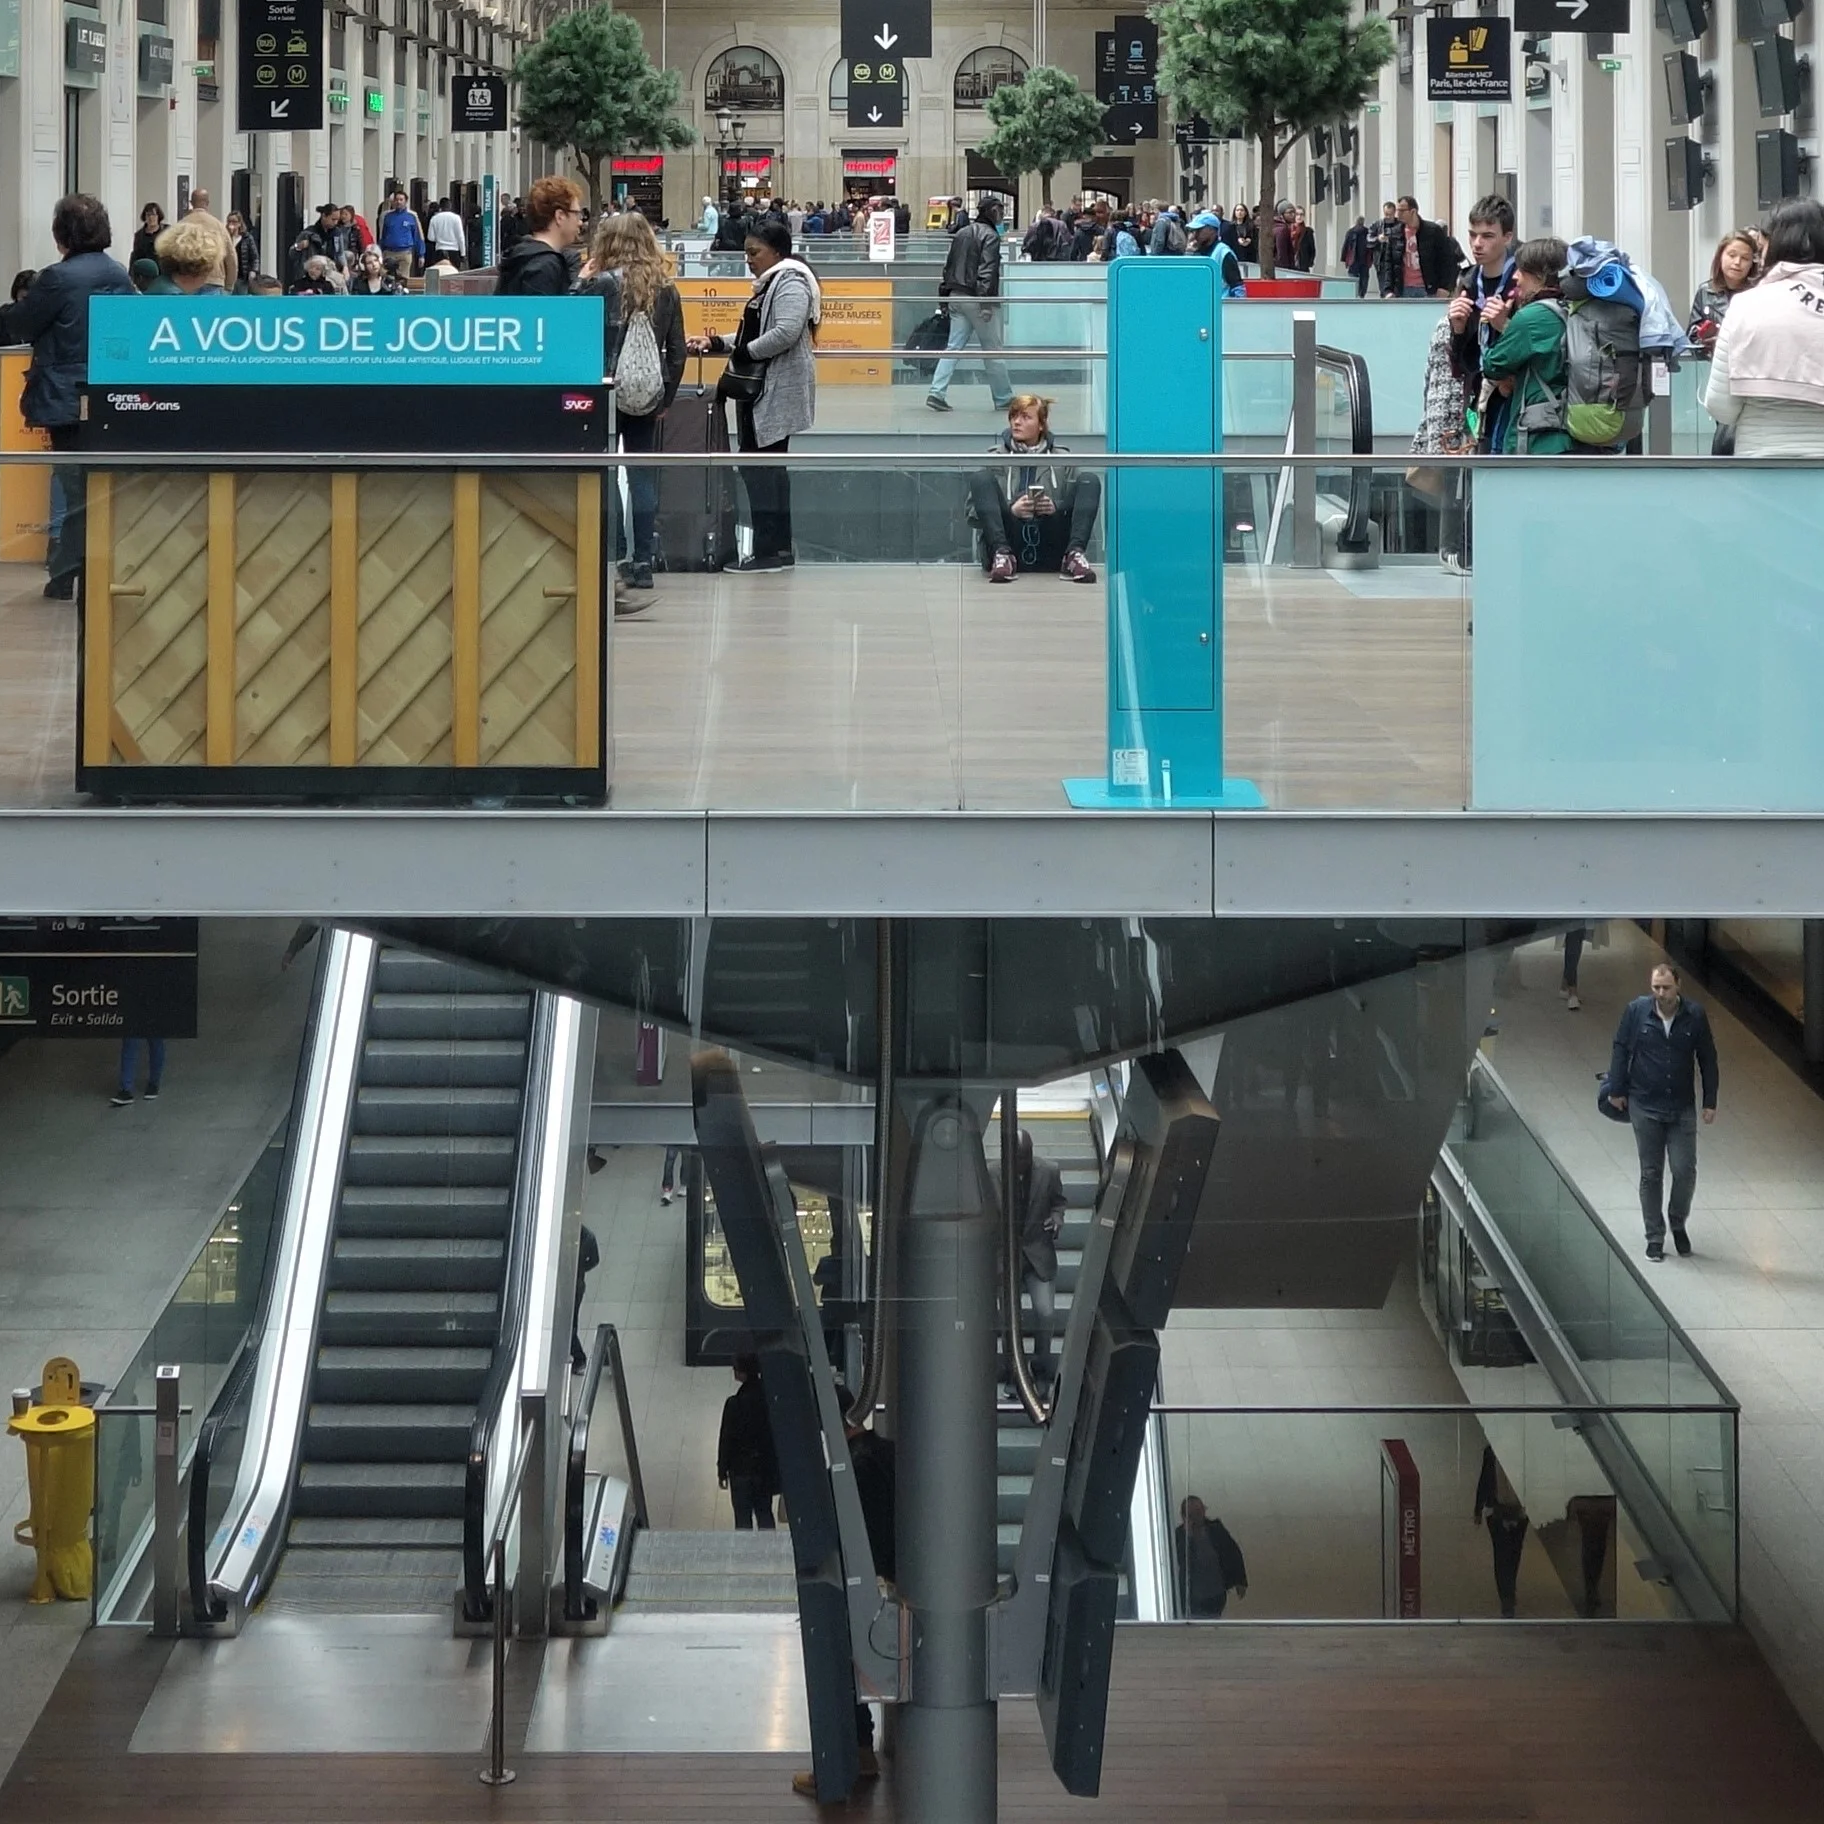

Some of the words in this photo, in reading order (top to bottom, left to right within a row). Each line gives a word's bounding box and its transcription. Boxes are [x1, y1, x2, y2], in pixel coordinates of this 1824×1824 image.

[268, 5, 295, 14] Sortie
[291, 69, 303, 79] M
[882, 66, 893, 76] M
[1121, 90, 1128, 101] 1
[1144, 90, 1152, 102] 5
[703, 288, 717, 297] 10
[820, 301, 854, 311] ALLÈLES
[820, 310, 846, 319] PARIS
[847, 310, 882, 319] MUSÉES
[149, 317, 180, 352] A
[192, 316, 305, 353] VOUS
[319, 317, 374, 352] DE
[385, 317, 522, 353] JOUER
[536, 317, 545, 352] !
[148, 356, 159, 364] LA
[159, 356, 178, 364] GARE
[238, 356, 248, 364] LA
[249, 356, 292, 364] DISPOSITION
[107, 393, 141, 403] Gares
[563, 399, 593, 411] SNCF
[51, 920, 64, 931] to
[51, 984, 119, 1006] Sortie
[50, 1013, 74, 1025] Exit
[86, 1012, 124, 1025] Salida
[1401, 1509, 1416, 1557] MÉTRO
